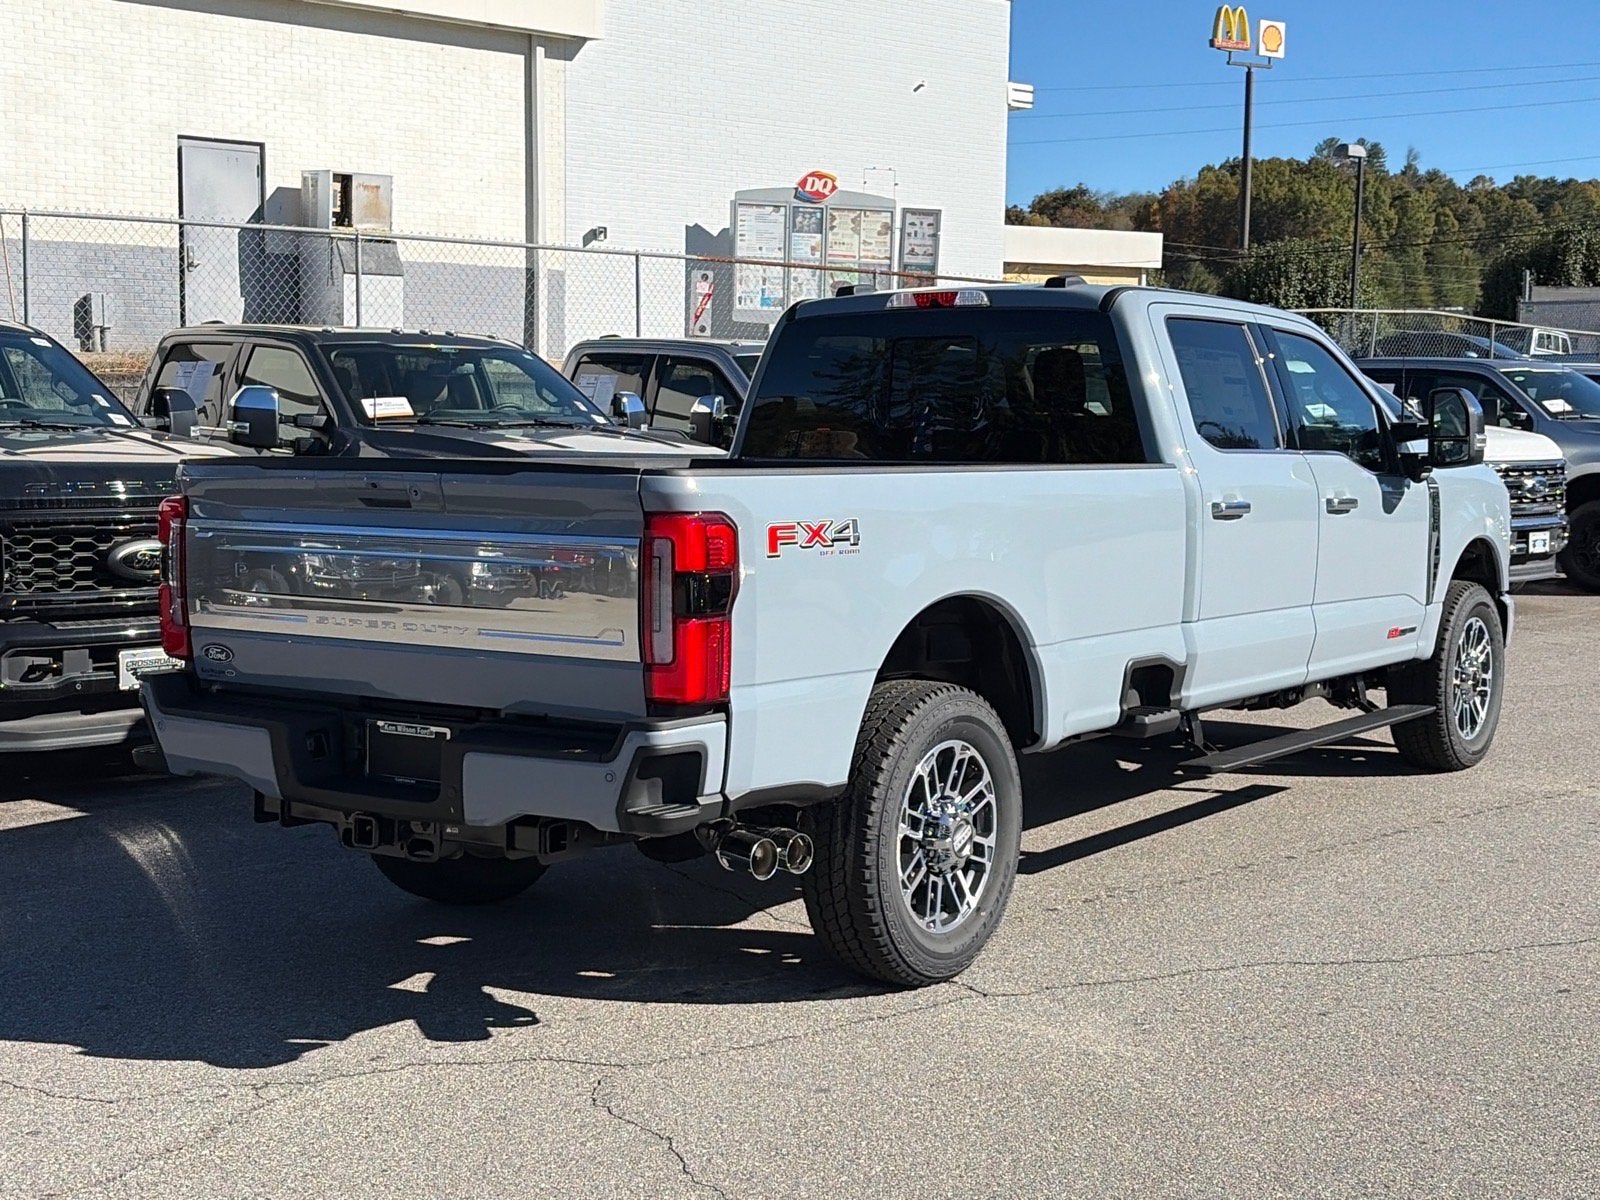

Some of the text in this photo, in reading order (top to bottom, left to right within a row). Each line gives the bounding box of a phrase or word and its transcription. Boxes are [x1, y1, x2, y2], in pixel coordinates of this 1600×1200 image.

[804, 176, 833, 195] DQ
[766, 518, 861, 558] FX4
[315, 615, 469, 635] SUPER DUTY
[208, 647, 226, 660] Ford
[384, 723, 431, 736] Ken Wilson Ford
